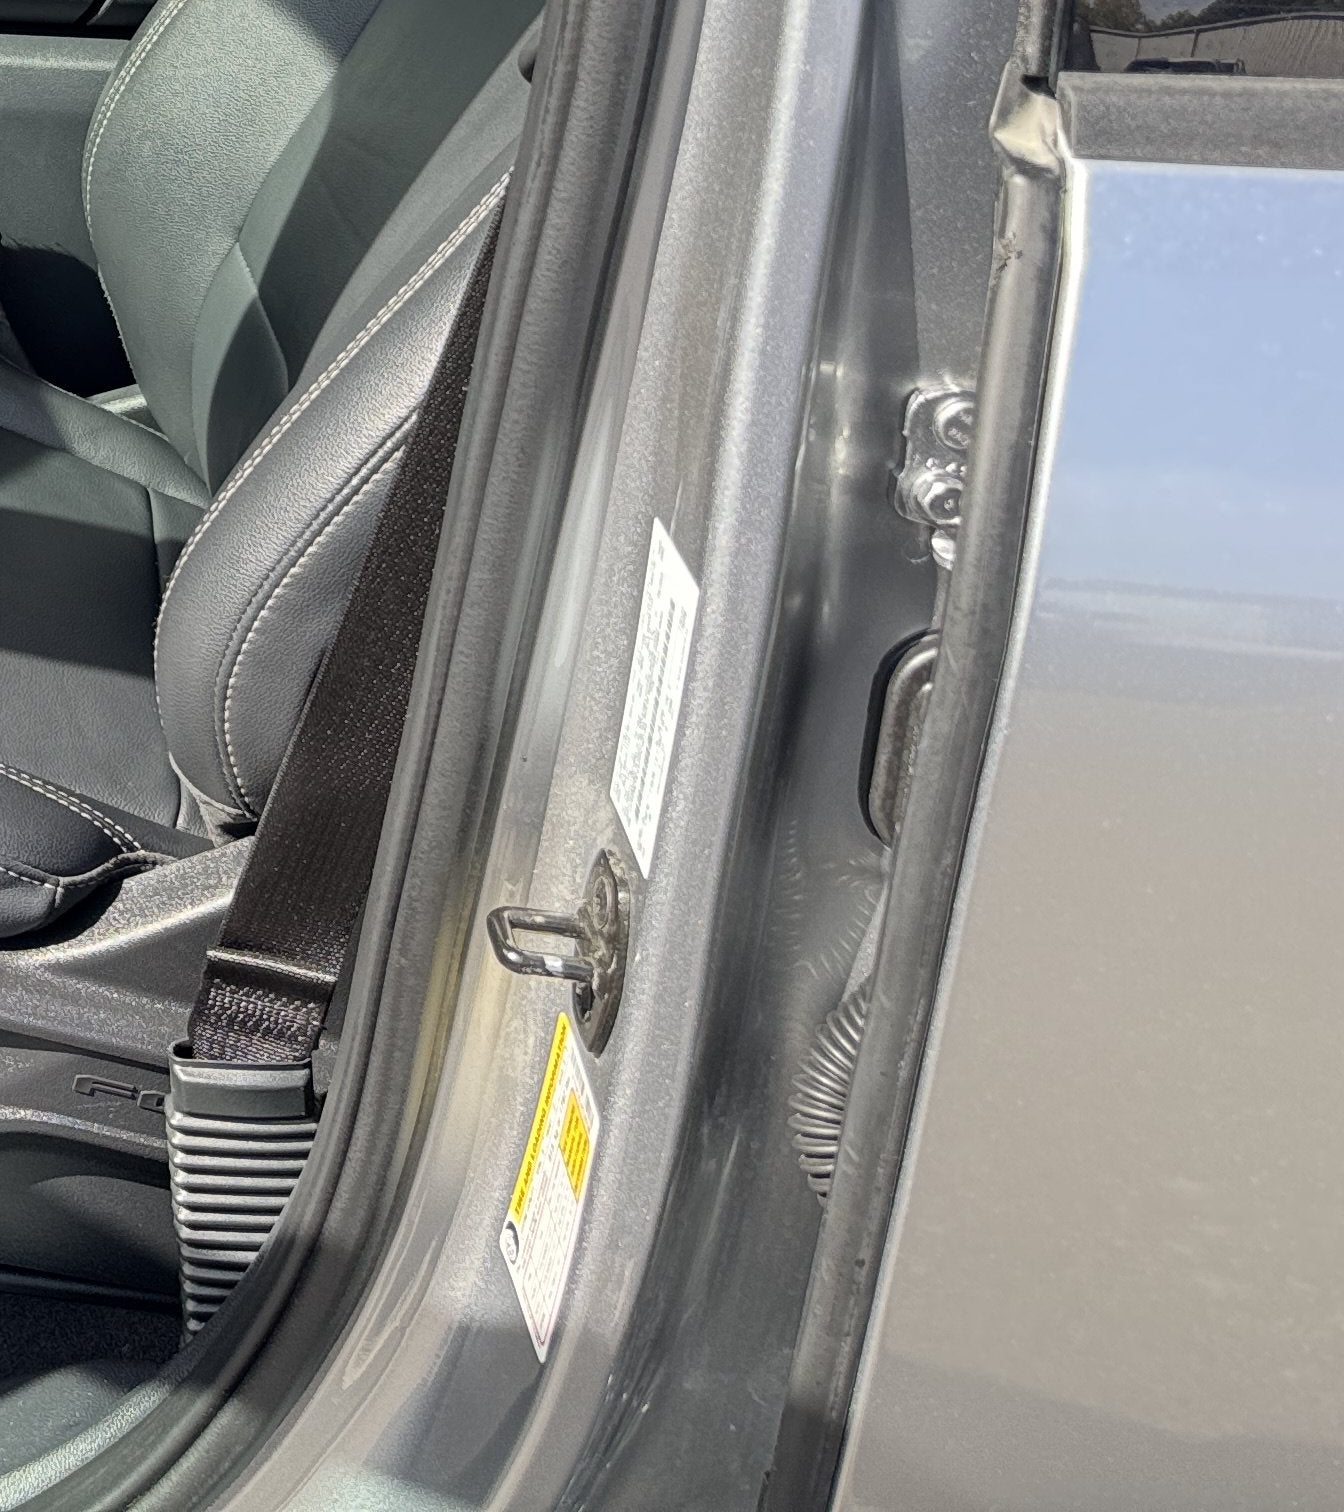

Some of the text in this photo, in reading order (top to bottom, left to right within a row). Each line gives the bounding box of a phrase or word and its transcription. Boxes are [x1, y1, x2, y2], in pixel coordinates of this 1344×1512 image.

[523, 1161, 533, 1187] AND
[531, 1108, 548, 1161] LOADING
[545, 1023, 567, 1105] INFORMATION
